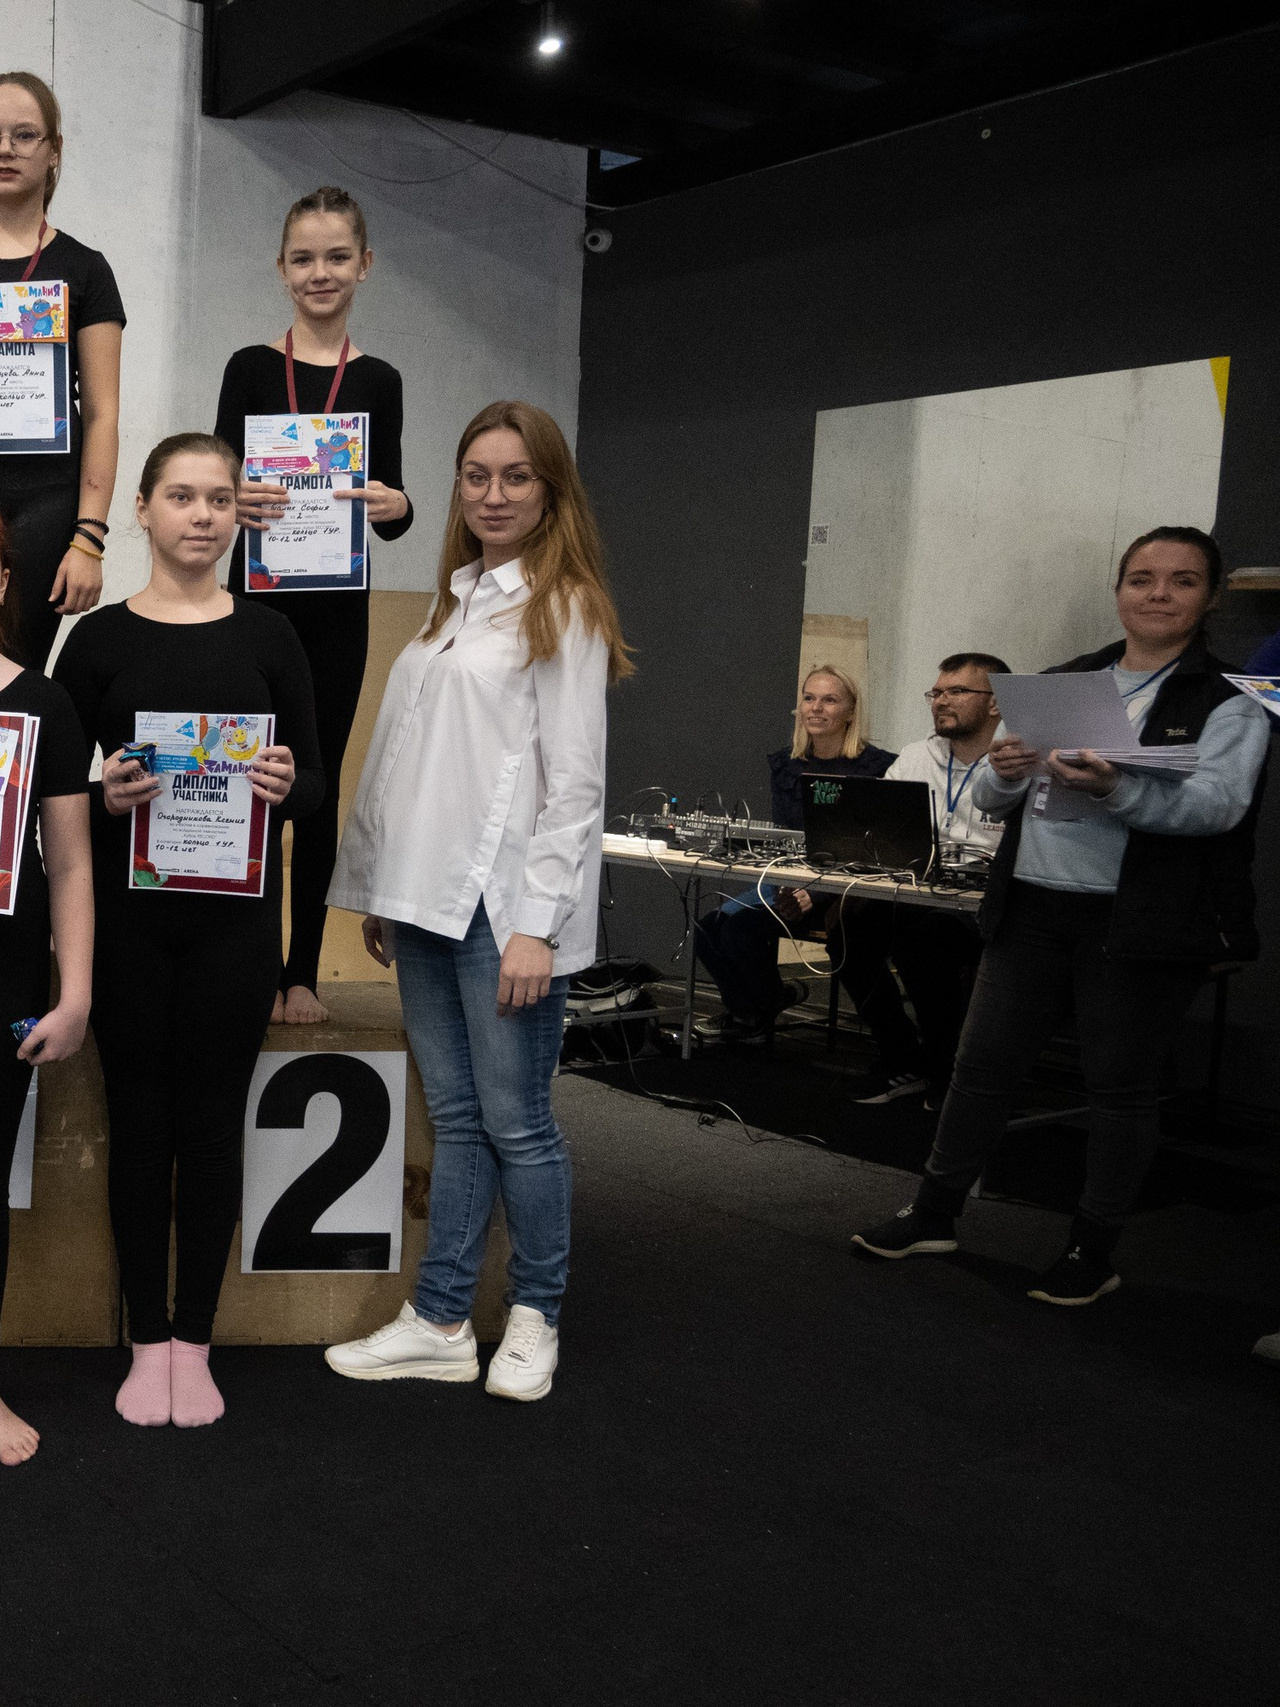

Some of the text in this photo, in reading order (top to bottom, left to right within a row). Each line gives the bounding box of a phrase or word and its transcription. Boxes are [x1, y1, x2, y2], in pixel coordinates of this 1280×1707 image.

[280, 475, 332, 490] ГРАМОТА
[301, 504, 330, 512] София
[172, 775, 228, 790] ДИПЛОМ
[173, 790, 228, 802] УЧАСТНИКА
[157, 812, 246, 824] Огородникова Ксения
[252, 1052, 391, 1270] 2
